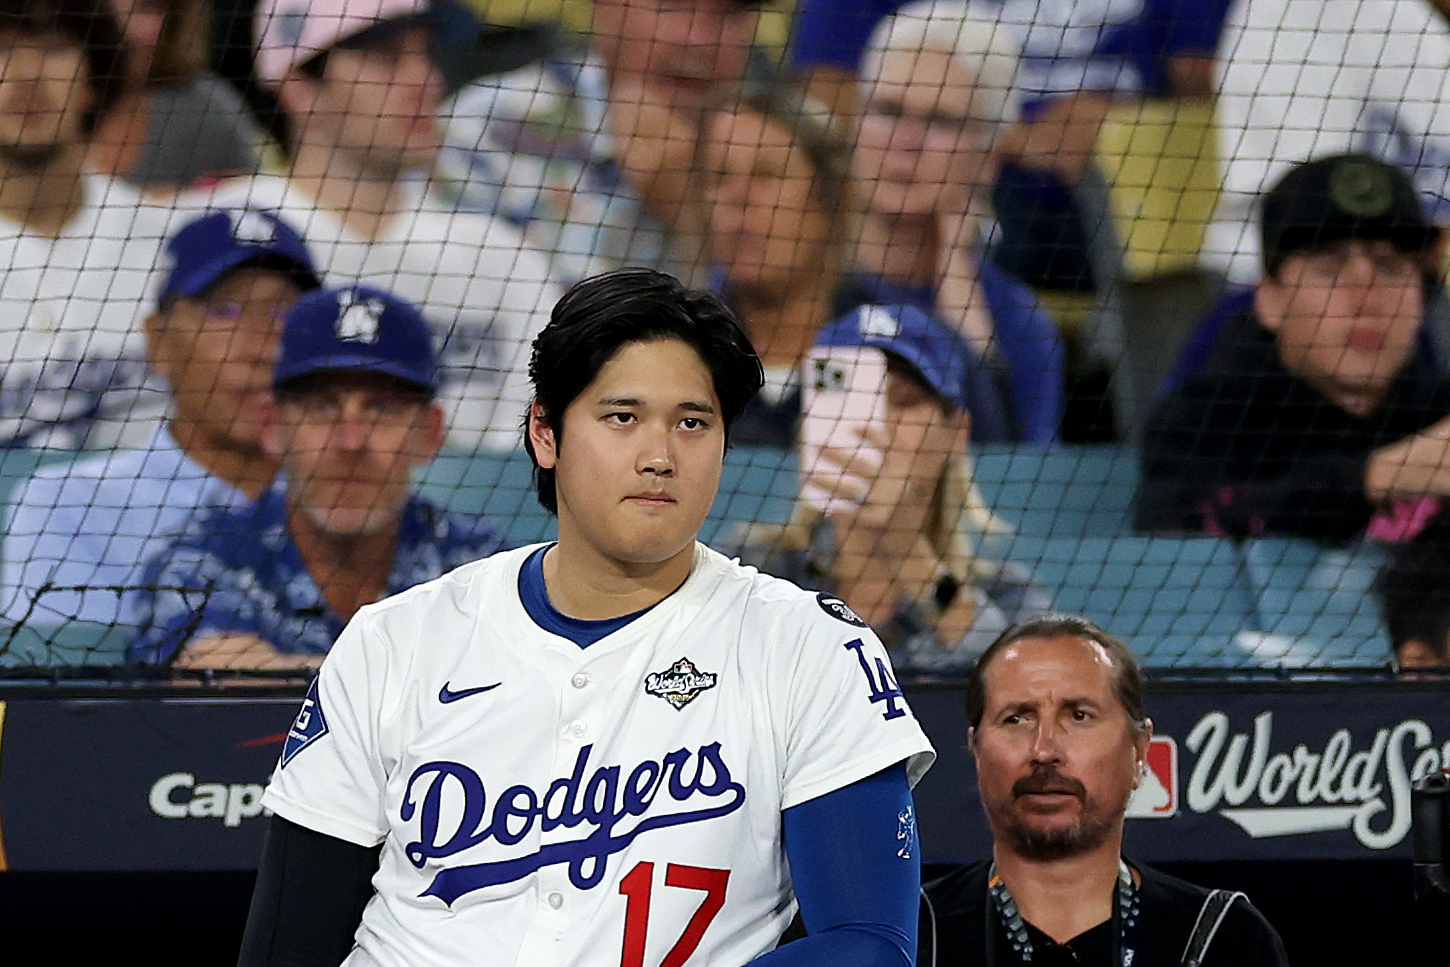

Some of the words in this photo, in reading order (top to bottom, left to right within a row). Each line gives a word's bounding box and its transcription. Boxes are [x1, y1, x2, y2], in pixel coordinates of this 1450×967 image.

[148, 772, 274, 827] Cap
[1186, 711, 1390, 813] World
[400, 741, 742, 892] Dodgers
